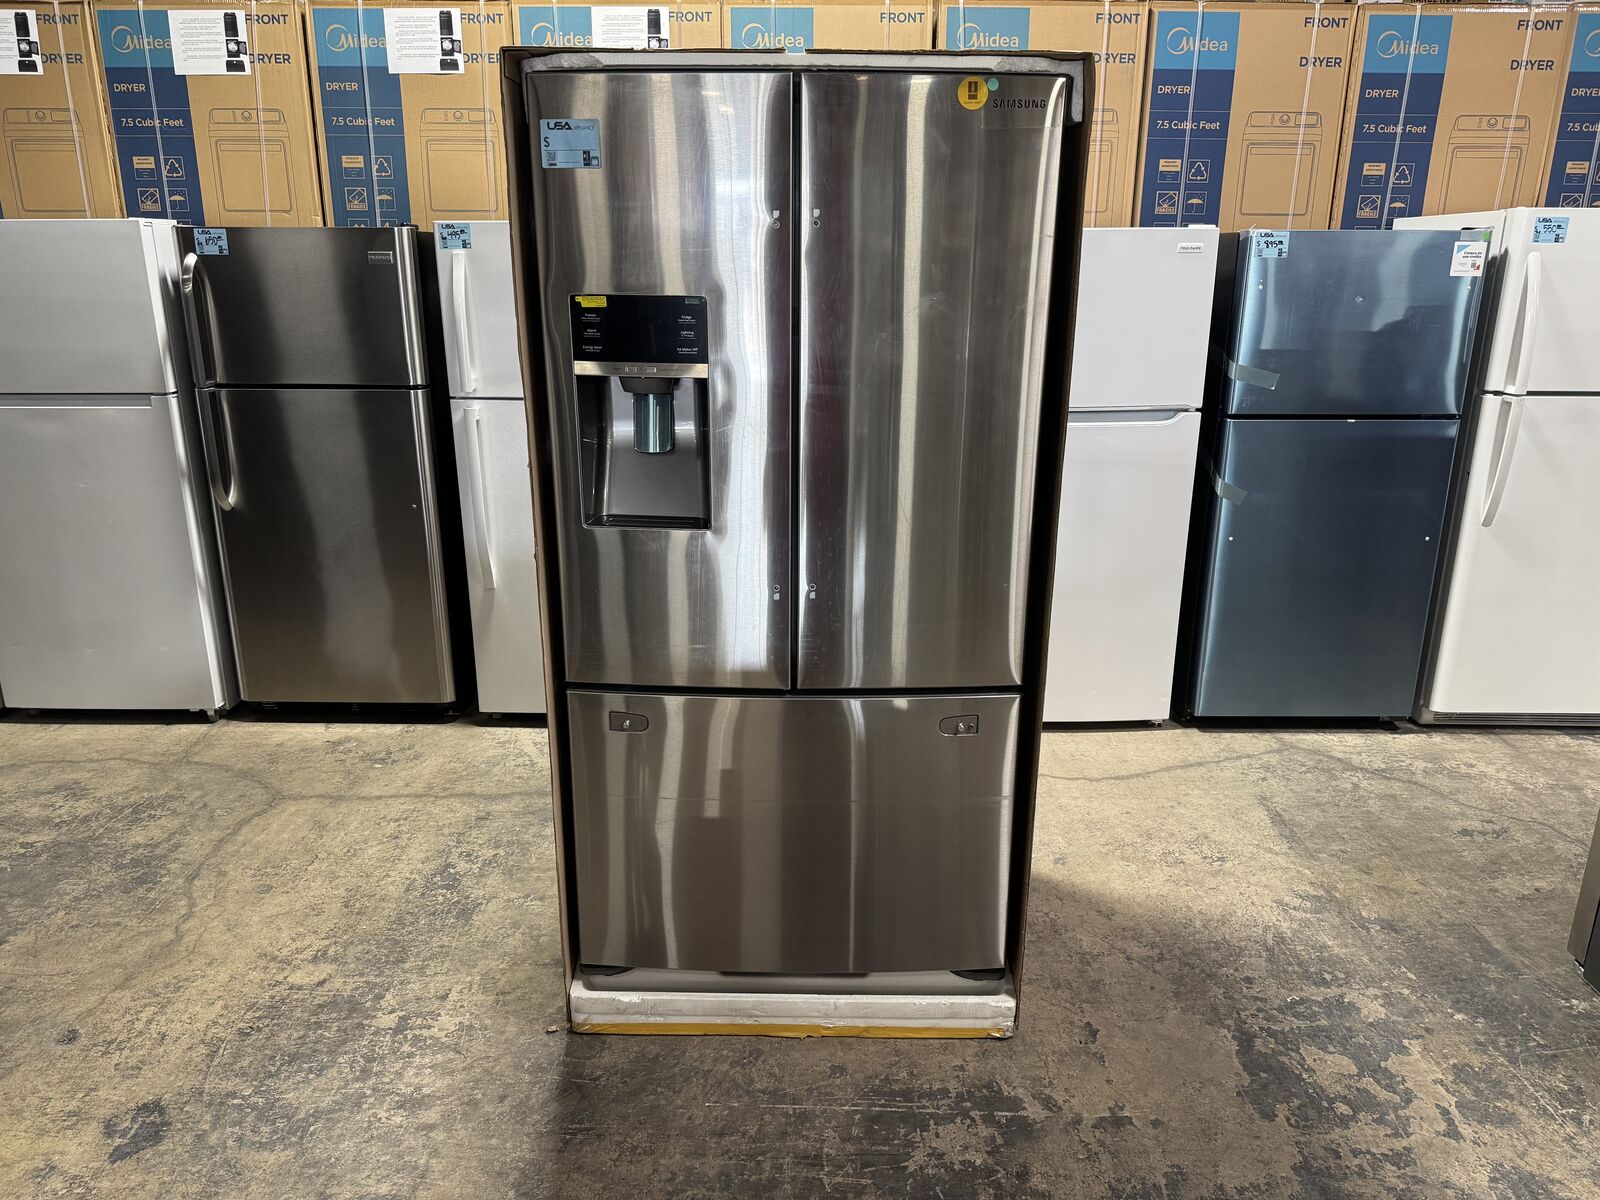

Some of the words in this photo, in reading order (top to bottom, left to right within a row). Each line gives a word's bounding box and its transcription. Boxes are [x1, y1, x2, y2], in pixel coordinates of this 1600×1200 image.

[36, 13, 79, 25] FRONT
[245, 13, 289, 25] FRONT
[460, 13, 504, 24] FRONT
[668, 11, 712, 22] FRONT
[880, 12, 925, 23] FRONT
[1095, 12, 1141, 24] FRONT
[745, 28, 804, 48] Midea
[961, 28, 1019, 49] Midea
[40, 53, 84, 64] DRYER
[249, 53, 292, 64] DRYER
[1093, 52, 1136, 64] DRYER
[1299, 56, 1342, 68] DRYER
[1510, 59, 1554, 71] DRYER
[113, 83, 146, 92] DRYER
[325, 82, 358, 91] DRYER
[1157, 85, 1191, 94] DRYER
[1571, 87, 1600, 97] DRYE
[1365, 89, 1399, 98] DRYER
[992, 98, 1046, 109] SAMSUNG
[120, 118, 134, 127] 7.5
[163, 118, 184, 127] Feet
[331, 117, 344, 126] 7.5
[374, 117, 396, 126] Feet
[546, 121, 573, 131] USA
[1156, 120, 1170, 129] 7.5
[1171, 120, 1198, 129] Cubic
[1199, 120, 1221, 130] Feet
[1566, 122, 1580, 132] 7.5
[1362, 124, 1376, 133] 7.5
[1377, 124, 1404, 133] Cubic
[1405, 124, 1428, 134] Feet
